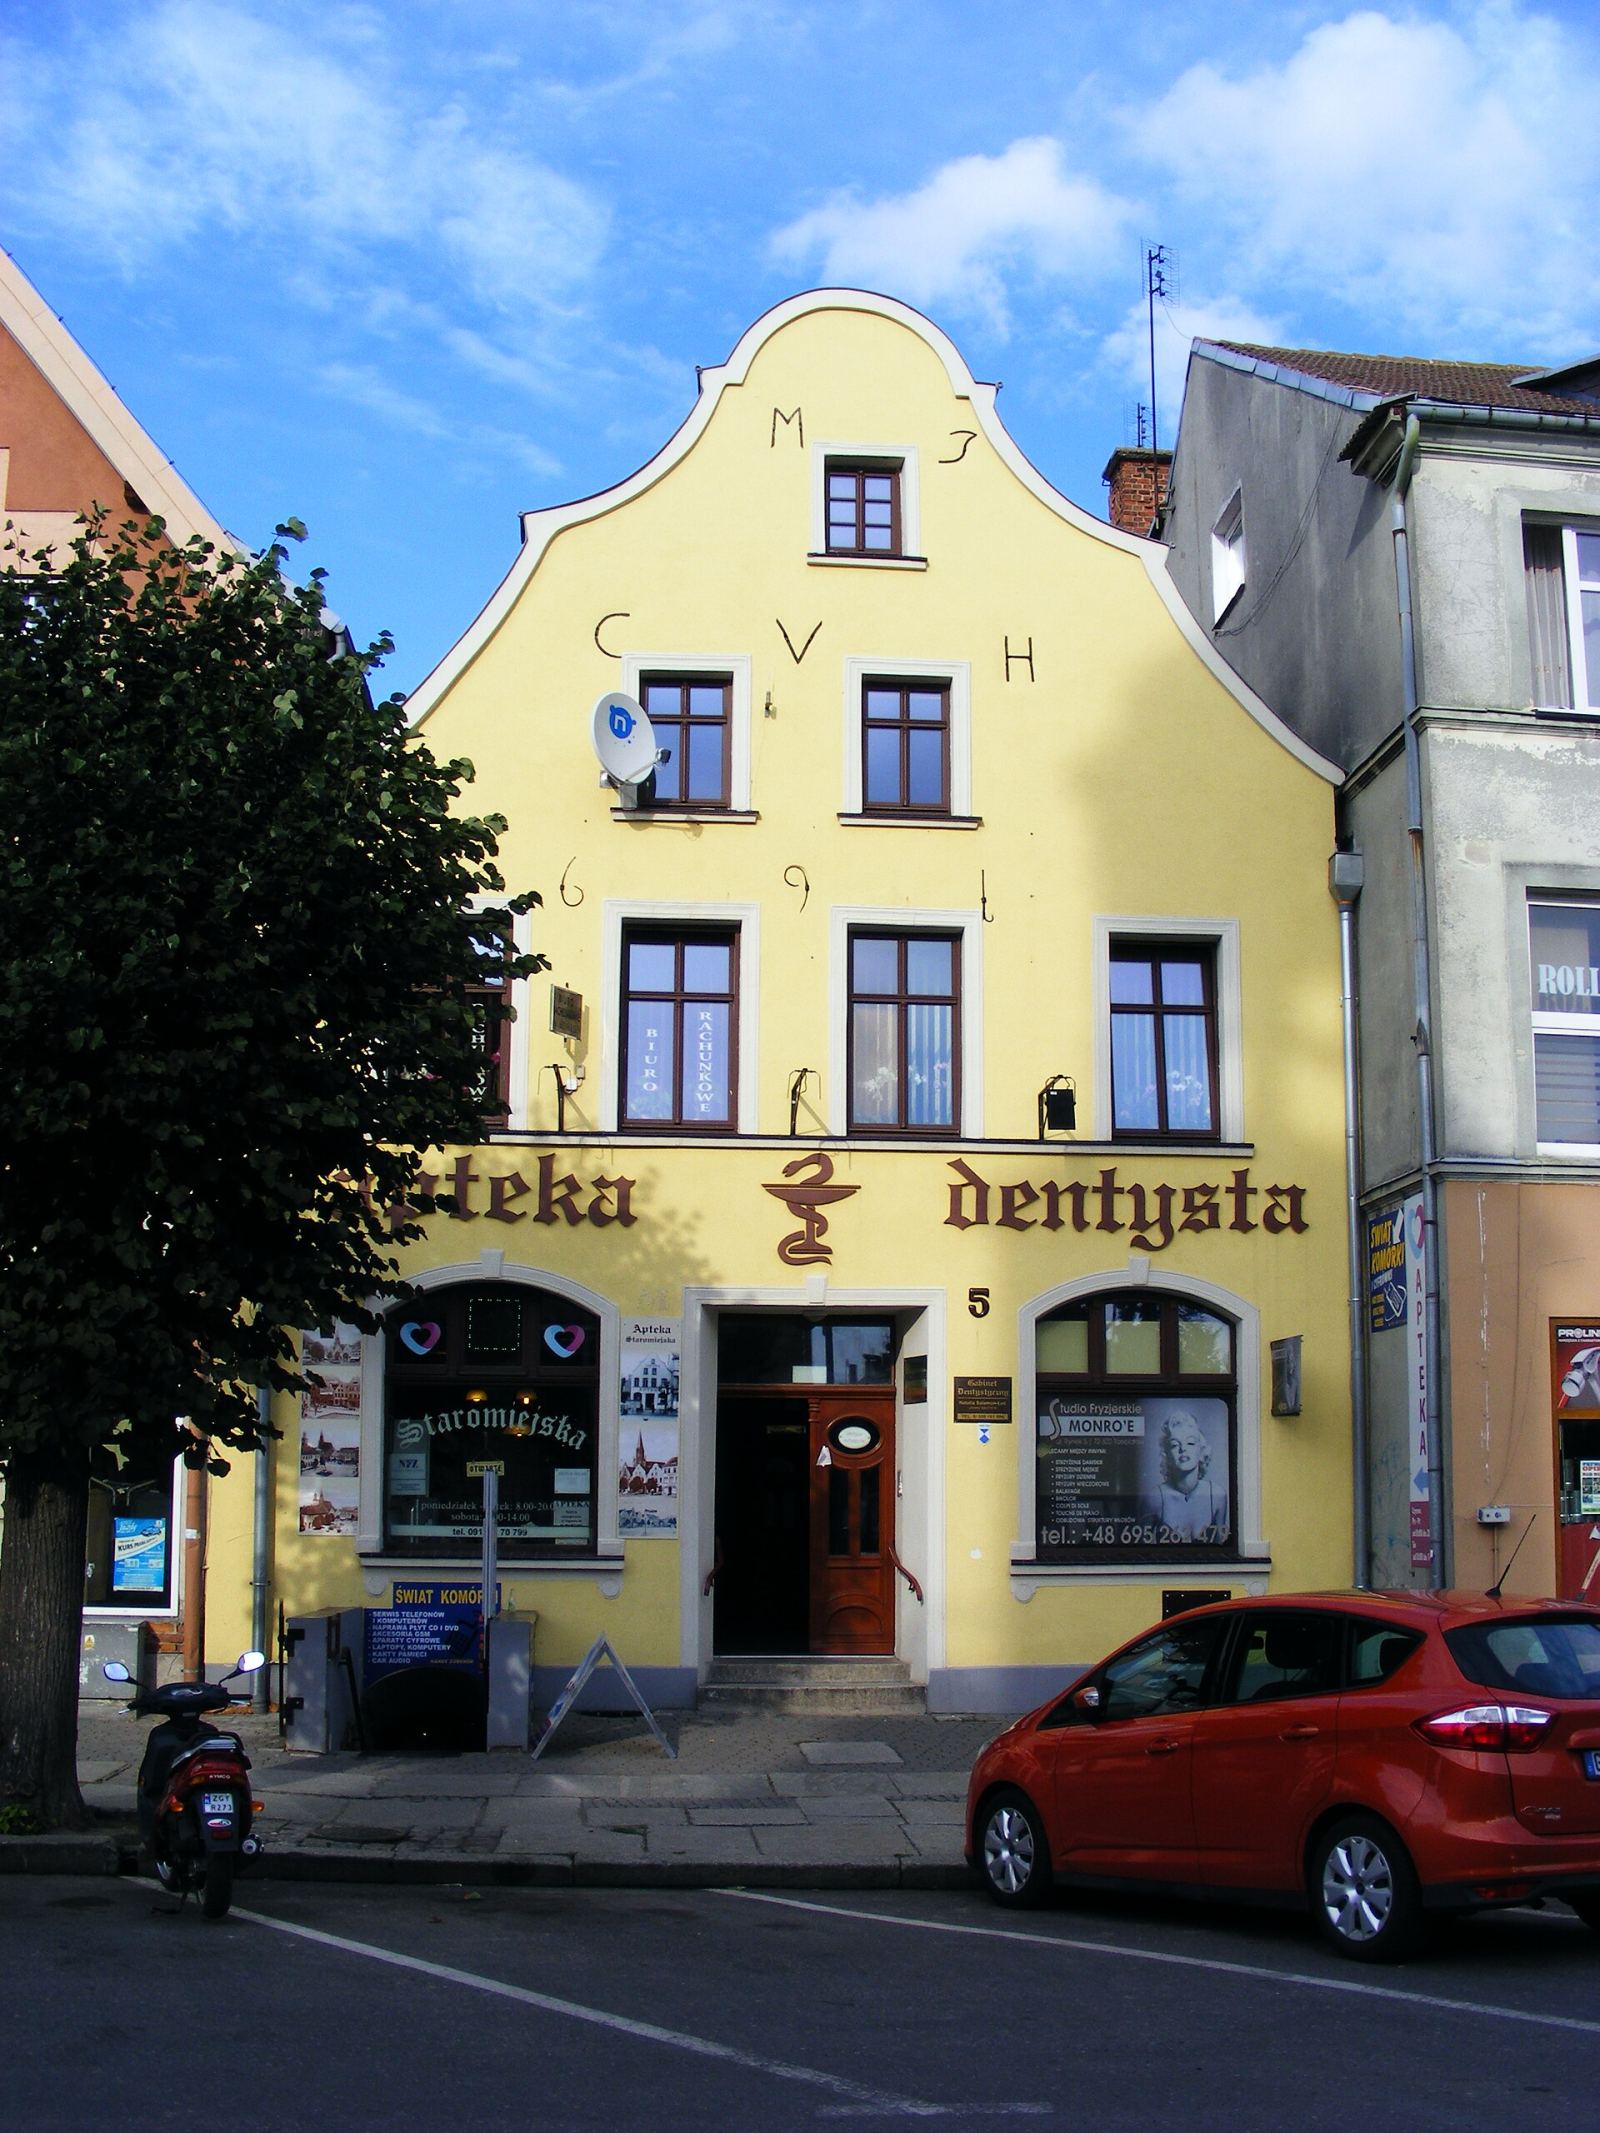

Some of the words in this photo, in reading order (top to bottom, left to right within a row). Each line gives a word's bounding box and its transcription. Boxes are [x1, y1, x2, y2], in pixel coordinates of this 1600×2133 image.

[770, 406, 804, 448] M
[594, 612, 630, 658] C
[775, 618, 823, 664] V
[1004, 635, 1035, 682] H
[643, 1028, 659, 1092] BIURO
[696, 1011, 714, 1113] RACHUNKOWE
[944, 1158, 1310, 1251] dentysta
[968, 1288, 990, 1318] 5
[633, 1324, 671, 1335] Apteka
[1415, 1268, 1427, 1456] APTEKA
[397, 1401, 588, 1450] Staromiejska
[1069, 1420, 1134, 1433] MONRO'E
[1089, 1403, 1142, 1415] Fryzjerskie
[1082, 1525, 1115, 1544] +48
[395, 1585, 434, 1604] ŚWIAT
